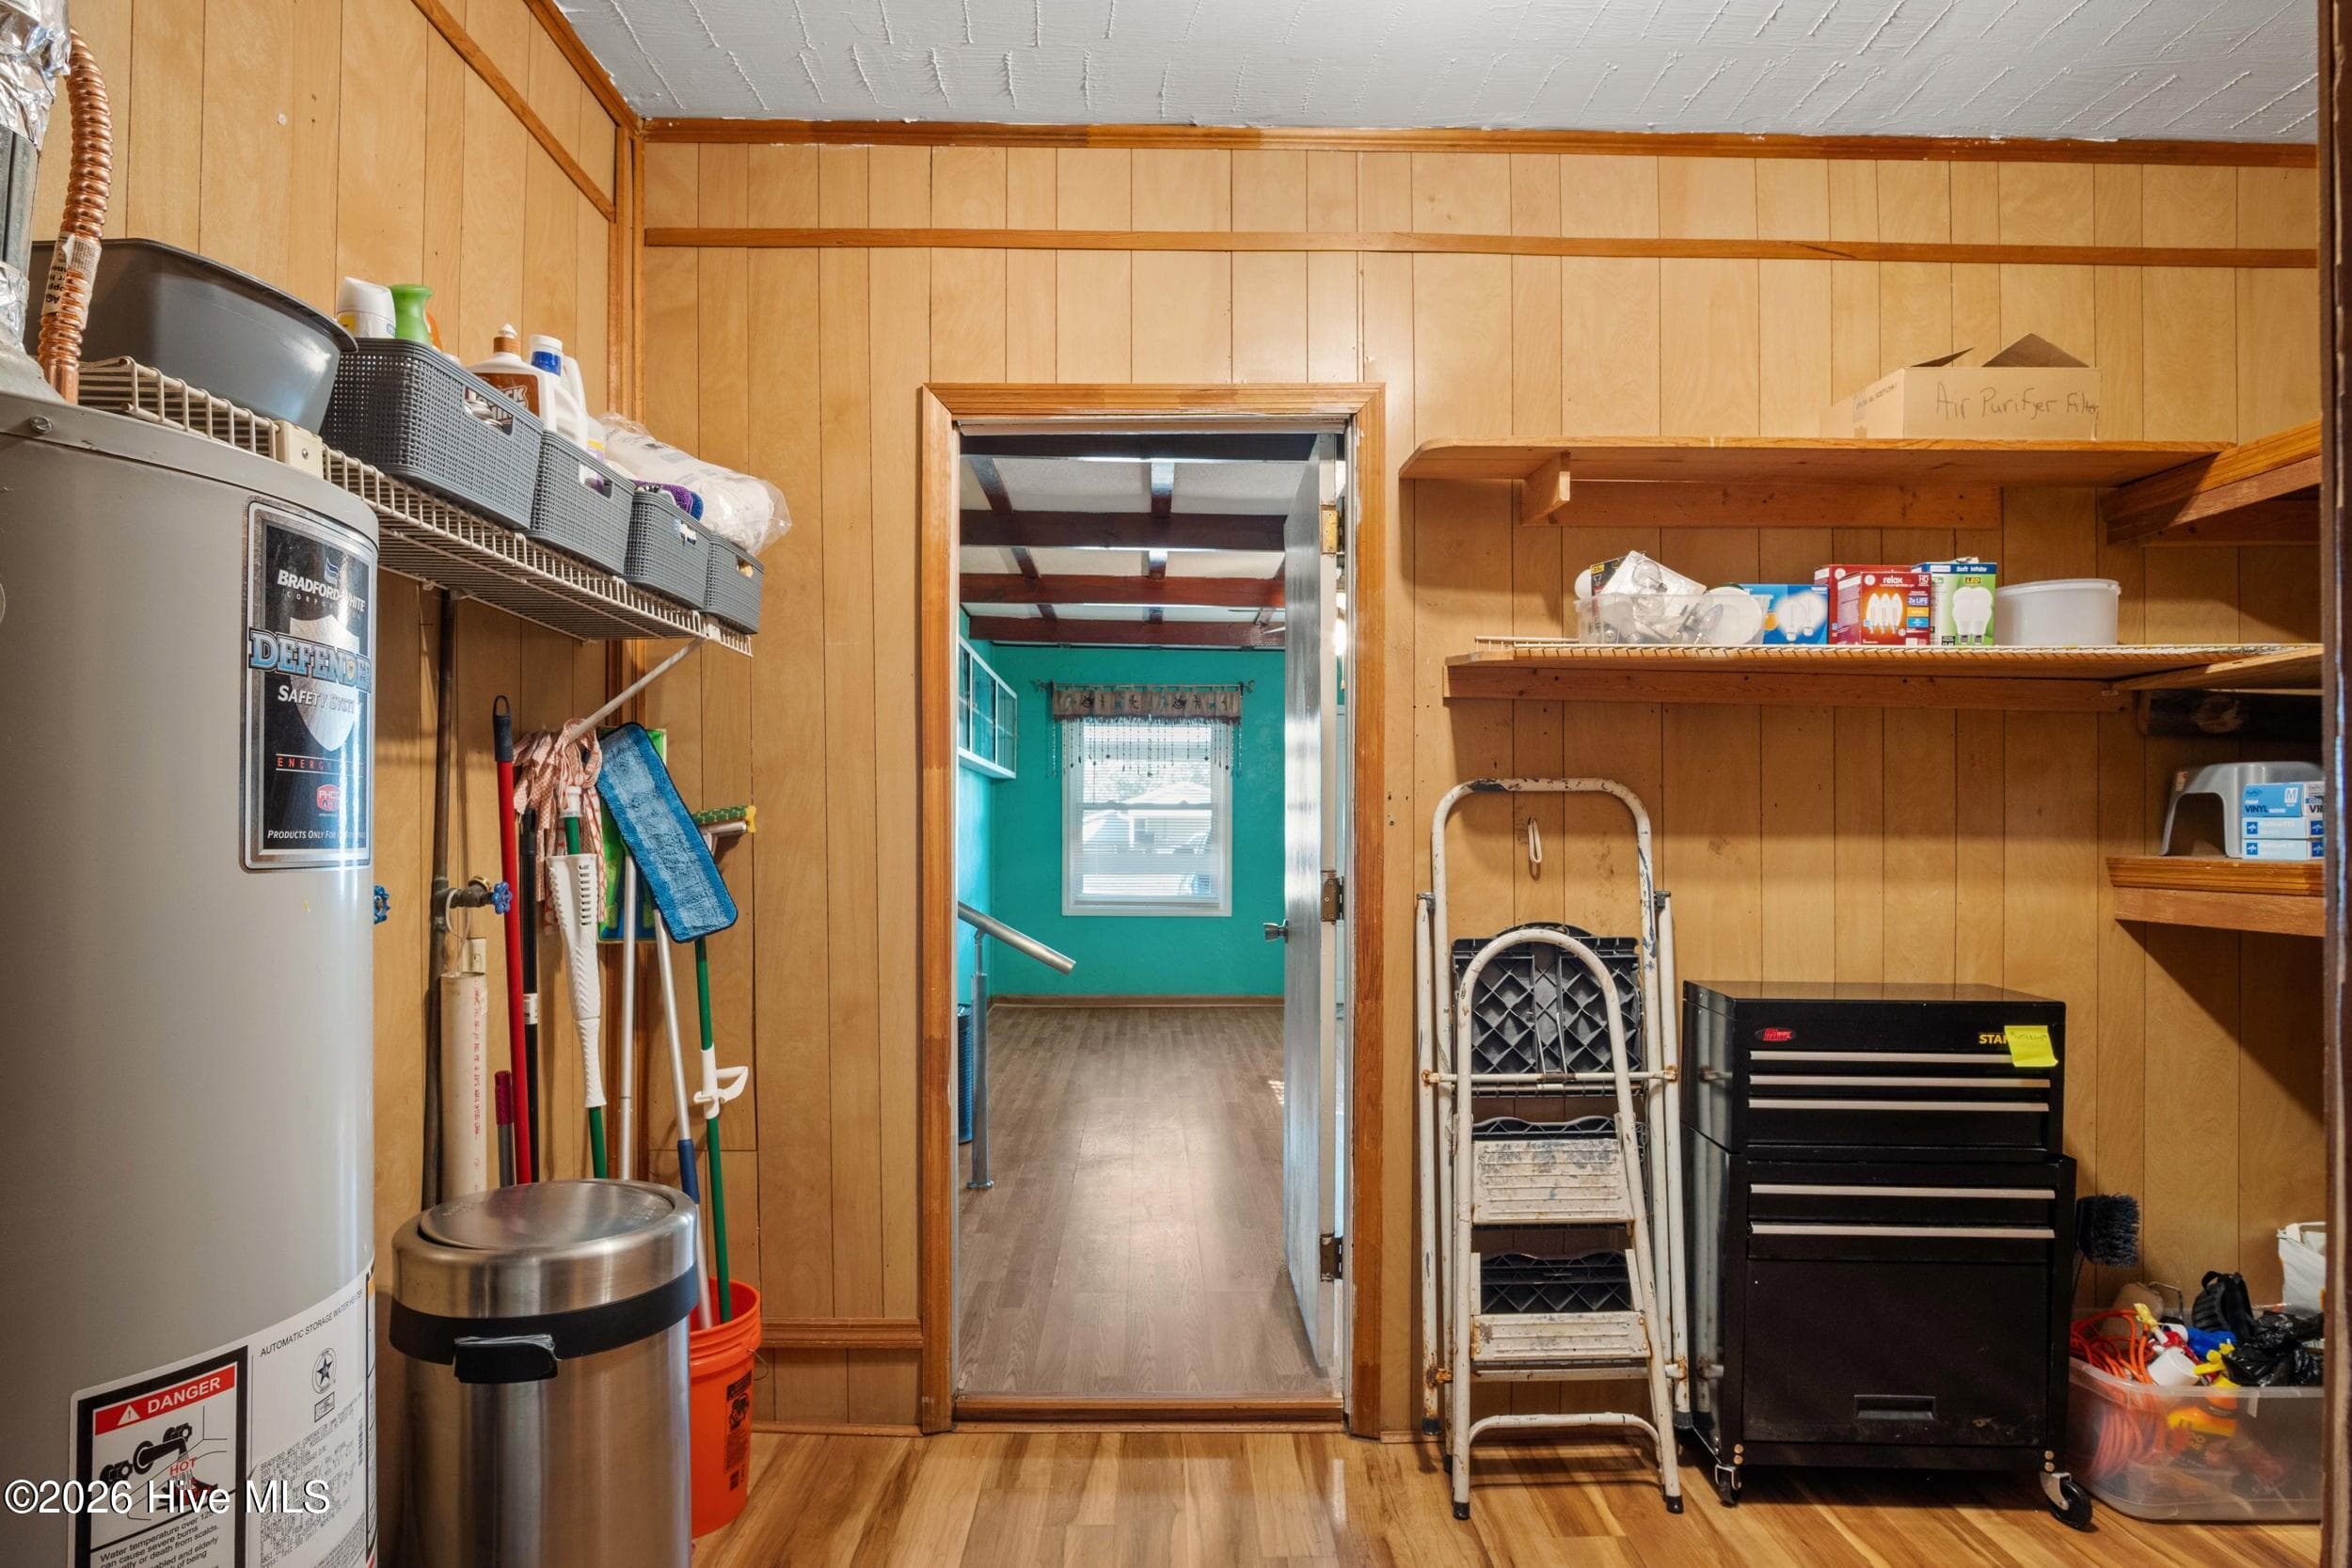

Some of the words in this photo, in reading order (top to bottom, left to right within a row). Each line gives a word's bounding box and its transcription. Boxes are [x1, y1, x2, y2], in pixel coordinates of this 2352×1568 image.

[1935, 381, 1971, 420] Air
[1883, 575, 1903, 584] relax
[278, 684, 328, 708] SAFETY
[2244, 805, 2268, 814] VINYL
[267, 829, 307, 839] PRODUCTS
[308, 830, 324, 839] ONLY
[260, 1329, 304, 1358] AUTOMATIC
[305, 1312, 333, 1336] STORAGE
[148, 1376, 221, 1415] DANGER
[169, 1457, 196, 1476] HOT
[100, 1547, 127, 1561] Water
[130, 1526, 180, 1551] temperature
[181, 1517, 199, 1529] over
[119, 1549, 146, 1563] cause
[148, 1536, 175, 1553] severe
[177, 1526, 199, 1540] burns
[138, 1556, 149, 1564] or
[150, 1544, 173, 1560] death
[175, 1537, 193, 1549] from
[178, 1547, 193, 1560] and
[194, 1536, 219, 1552] elderly
[186, 1550, 208, 1565] being
